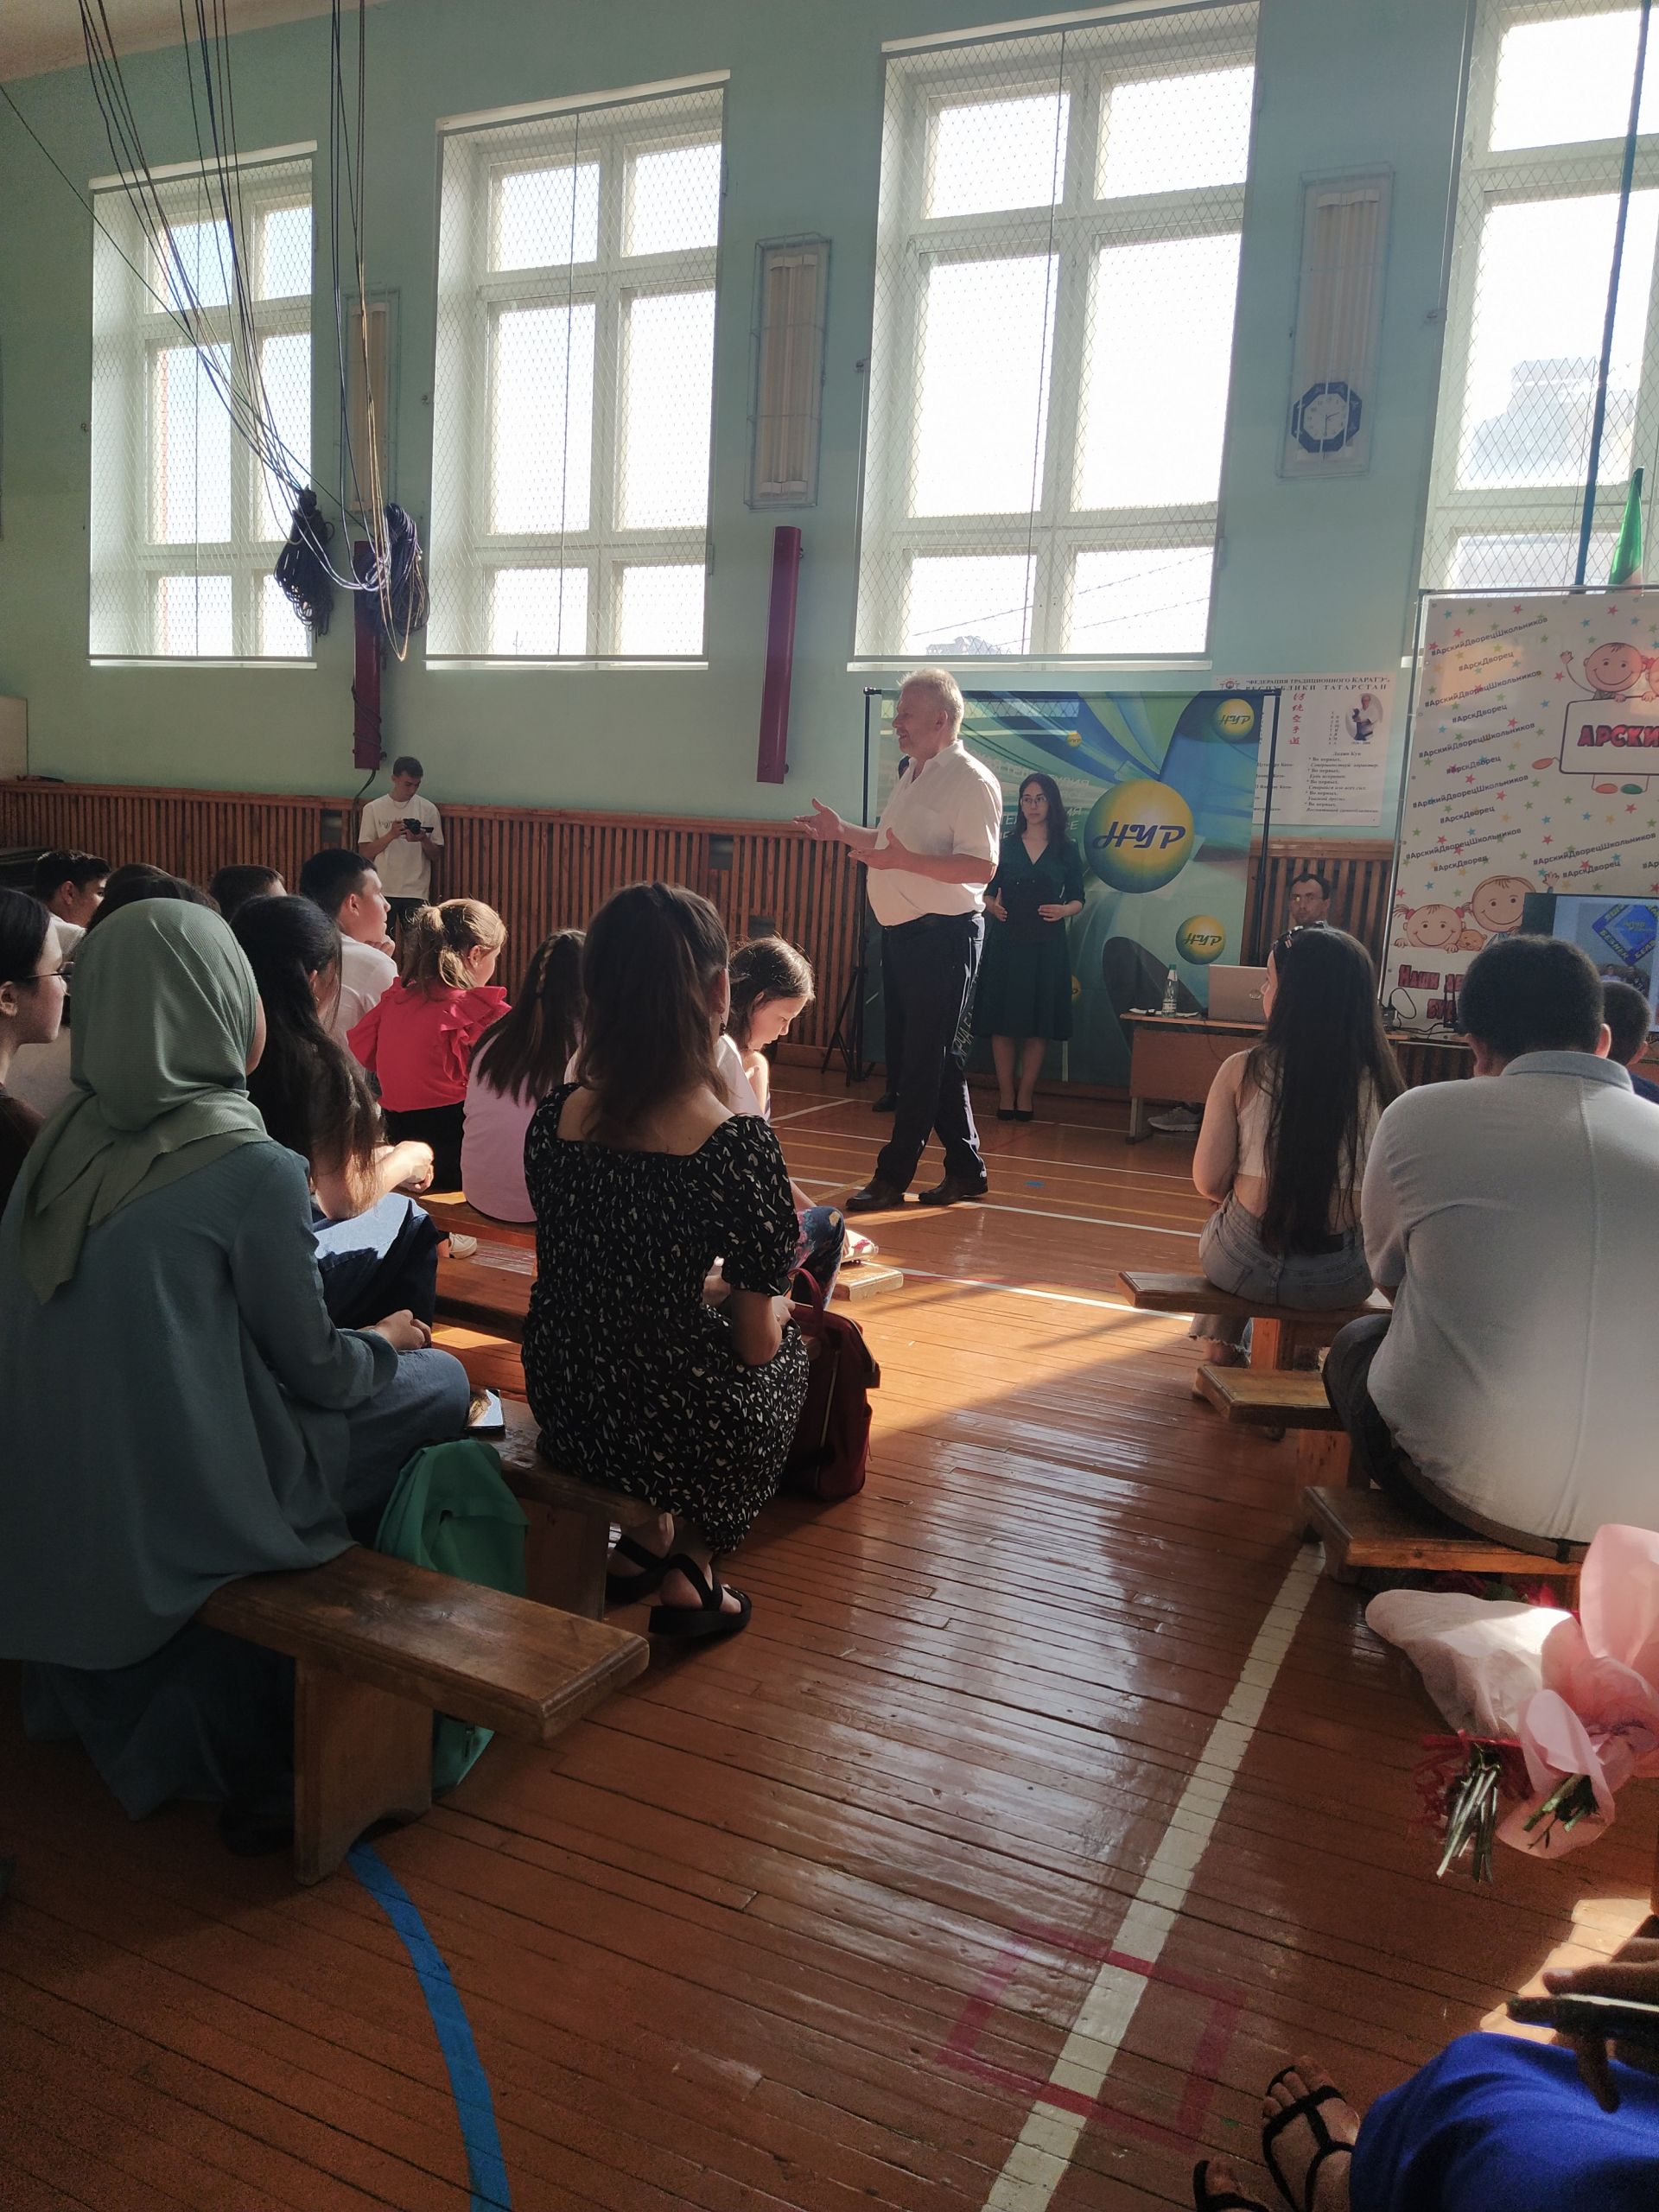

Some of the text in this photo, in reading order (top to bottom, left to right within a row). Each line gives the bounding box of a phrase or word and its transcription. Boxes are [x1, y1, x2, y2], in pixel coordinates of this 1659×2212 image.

[1431, 616, 1548, 656] #АрскийДворецШкольников
[1459, 652, 1514, 671] #АрскДворец
[1324, 683, 1387, 691] ТАТАРСТАН
[1425, 670, 1541, 708] #АрскийДворецШкольников
[1217, 714, 1251, 726] НУР
[1452, 704, 1508, 724] #АрскДворец
[1419, 722, 1535, 759] #АрскийДворецШкольников
[1446, 755, 1502, 774] #АрскДворец
[1413, 775, 1529, 809] #АрскийДворецШкольников
[1440, 805, 1495, 824] #АрскДворец
[1092, 821, 1186, 849] НУР
[1406, 828, 1522, 860] #АрскийДворецШкольников
[1533, 832, 1656, 866] #АрскийДворецШкольников
[1433, 855, 1489, 873] #АрскДворец
[1562, 861, 1621, 879] #АрскДворец
[1183, 932, 1223, 946] НУР
